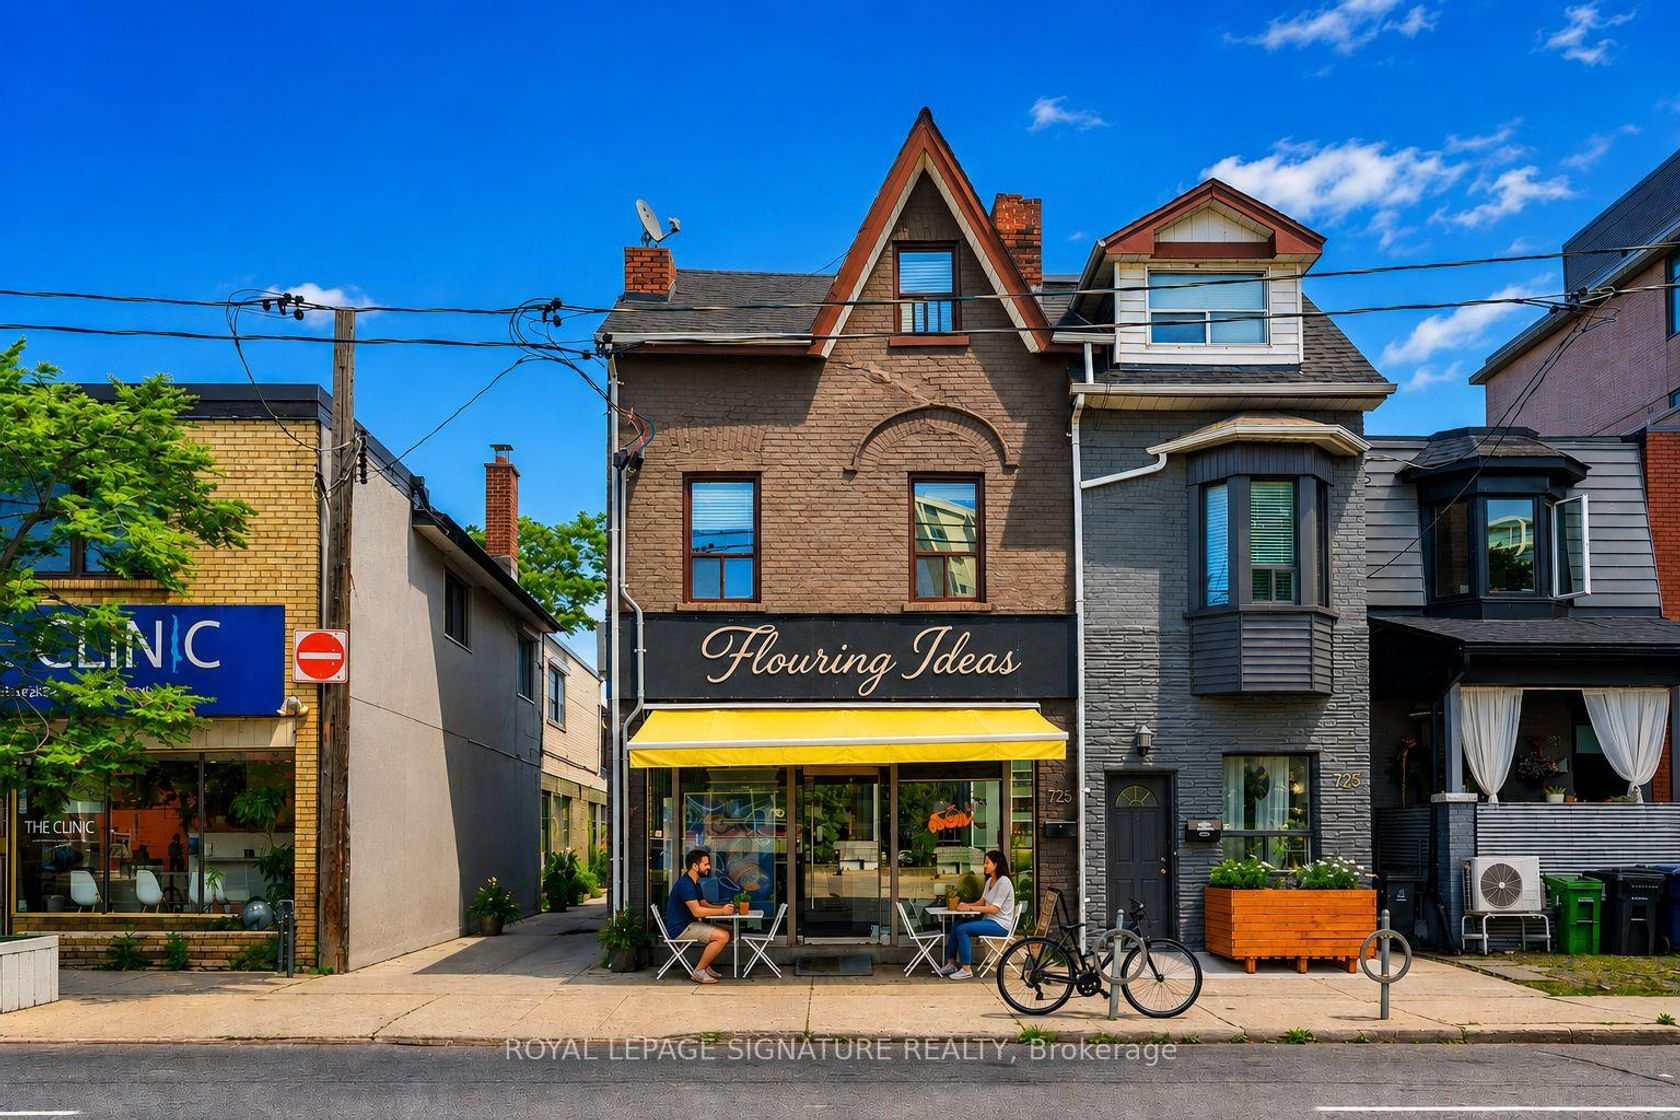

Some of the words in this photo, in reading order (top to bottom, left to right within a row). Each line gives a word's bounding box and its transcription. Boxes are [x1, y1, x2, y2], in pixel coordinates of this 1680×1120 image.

[701, 624, 897, 696] Flouring
[902, 625, 1022, 680] Ideas
[1333, 773, 1361, 788] 725
[24, 820, 50, 834] THE
[53, 820, 95, 834] CLINIC
